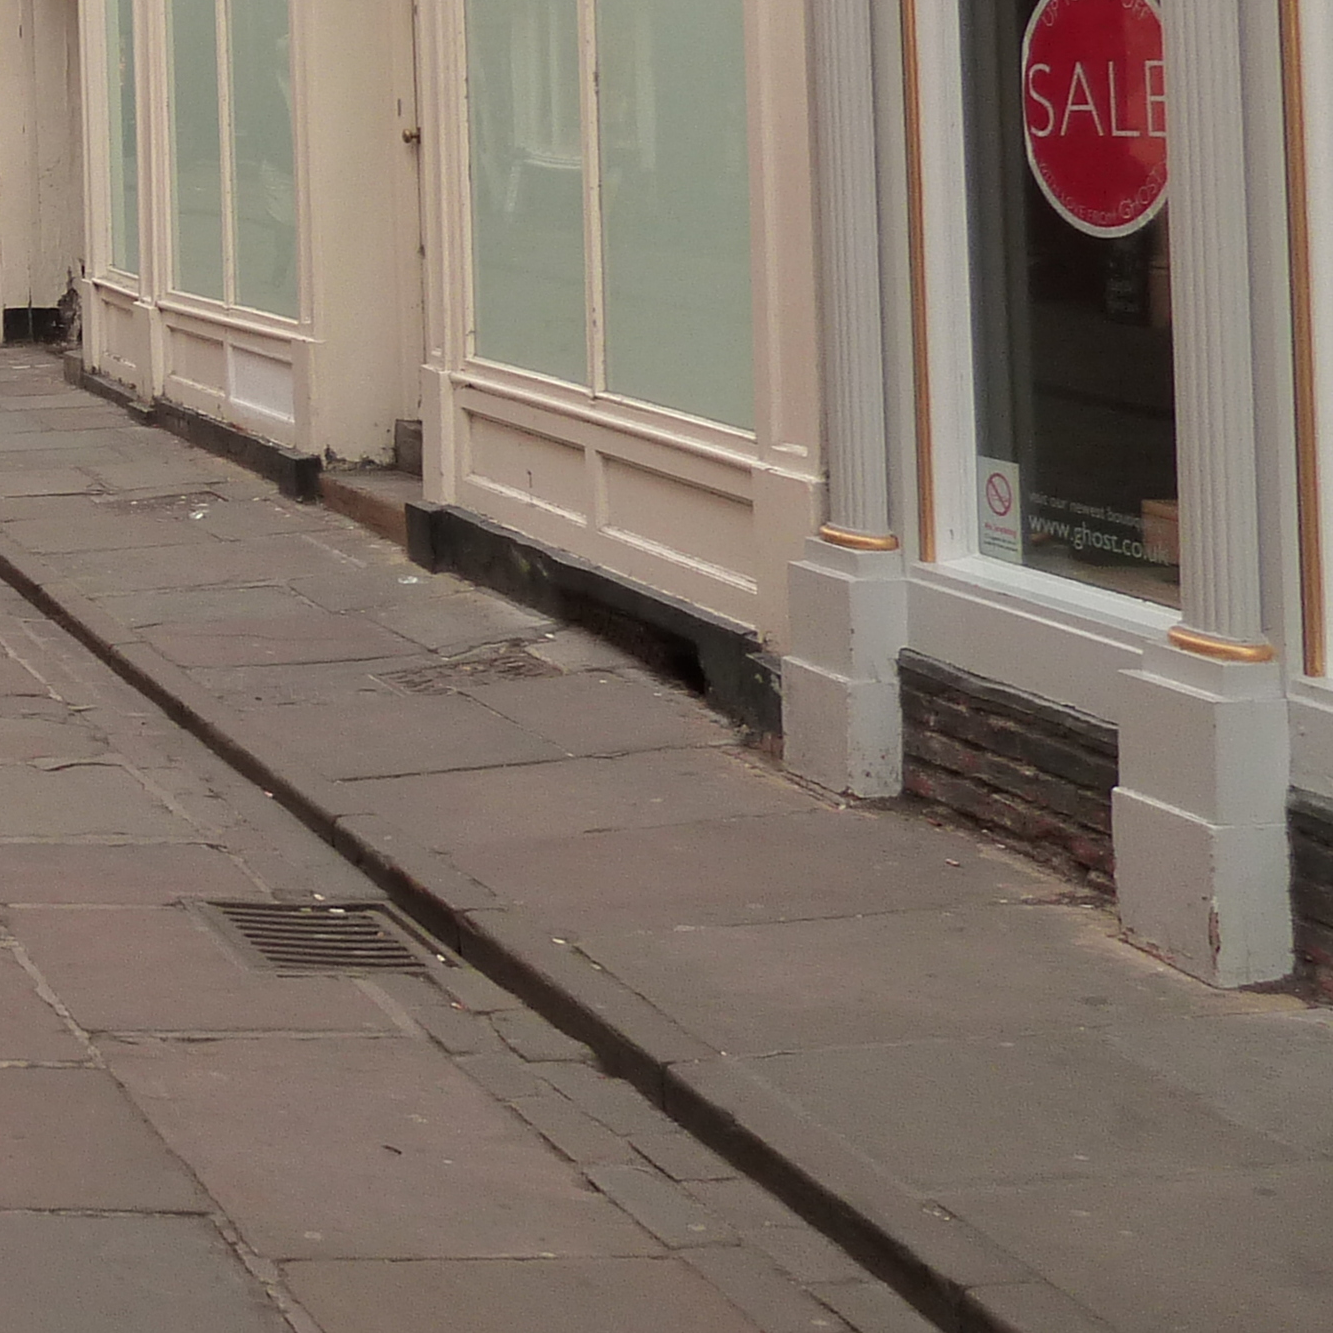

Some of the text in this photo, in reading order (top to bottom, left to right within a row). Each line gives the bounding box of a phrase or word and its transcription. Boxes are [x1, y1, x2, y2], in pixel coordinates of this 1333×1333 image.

[1028, 60, 1167, 138] SALE
[1069, 502, 1105, 519] newest
[1029, 514, 1170, 566] www.ghost.co.uk
